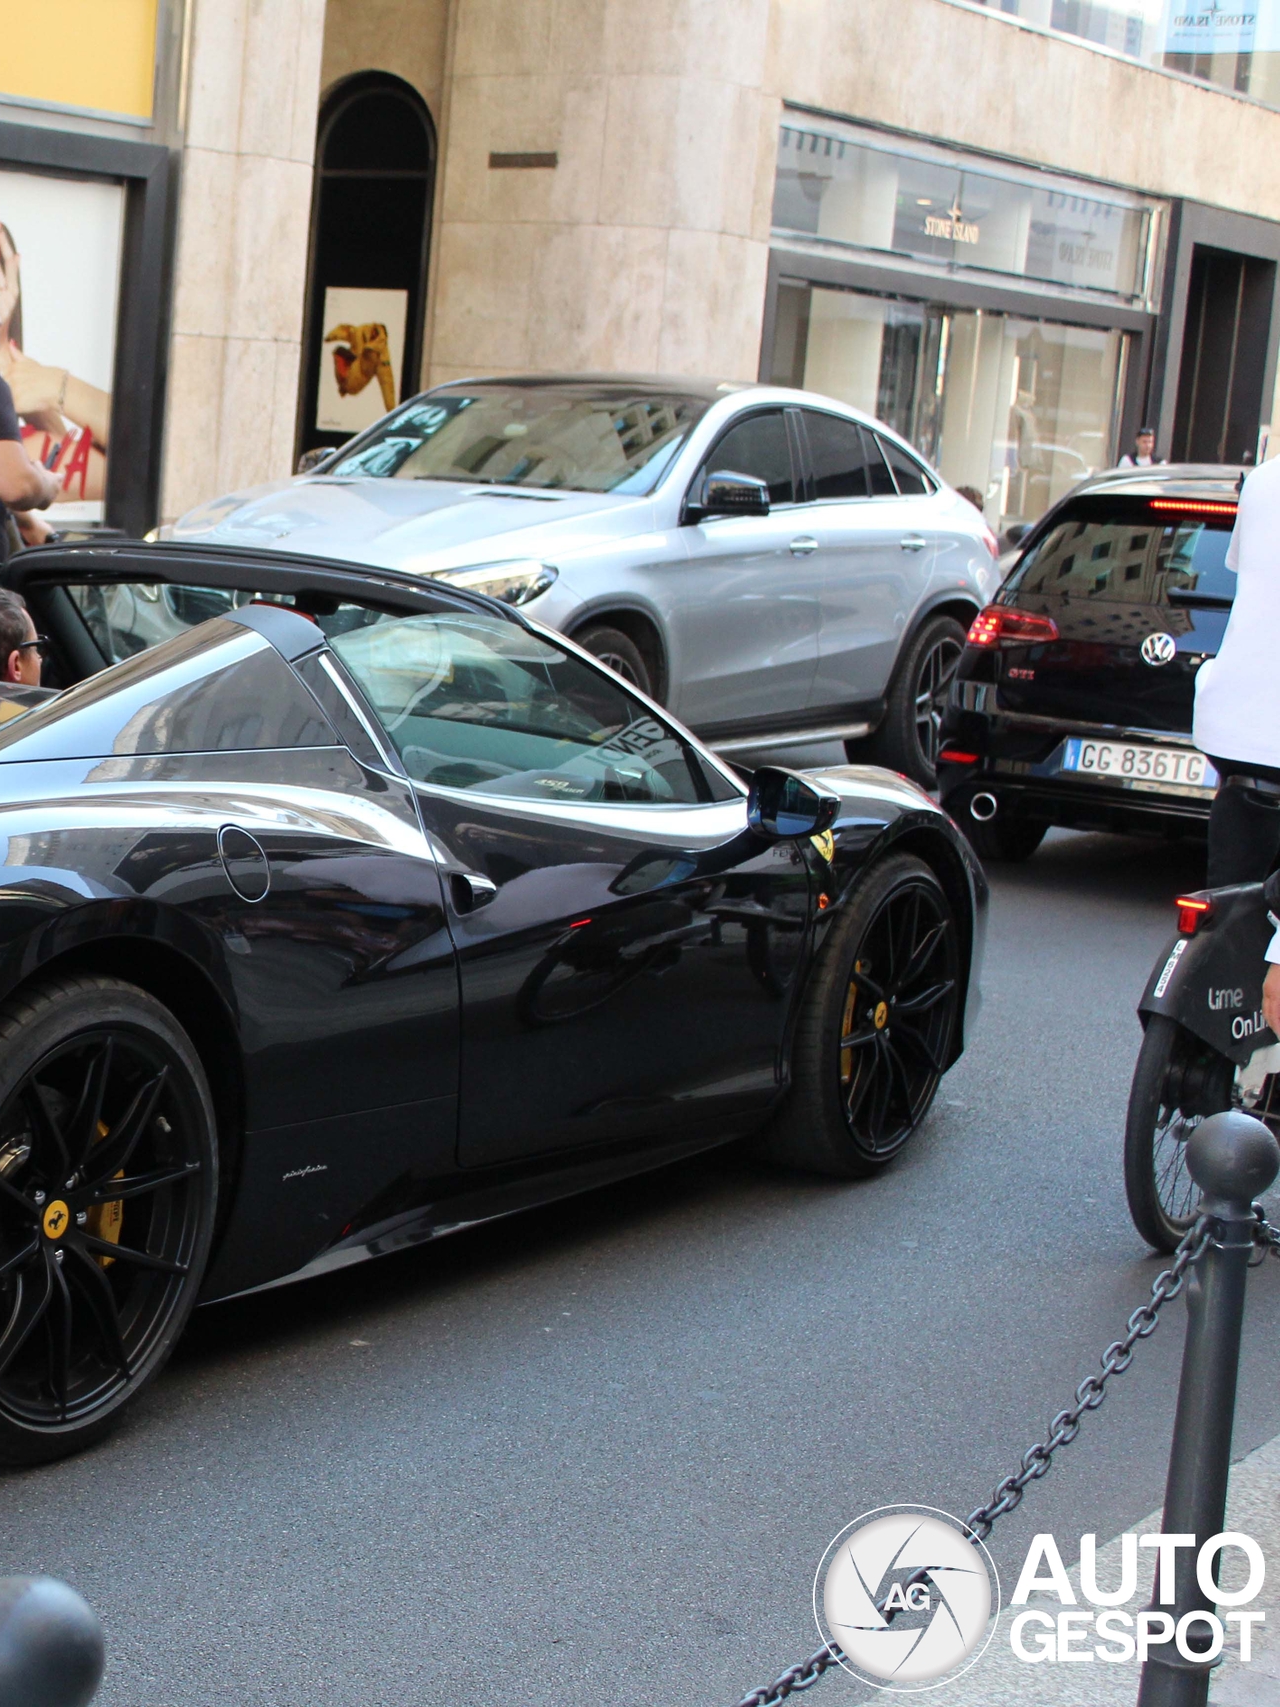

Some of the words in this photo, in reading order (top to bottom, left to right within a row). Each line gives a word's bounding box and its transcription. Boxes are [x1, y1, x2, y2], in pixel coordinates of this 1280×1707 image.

[924, 215, 952, 240] STONE
[953, 222, 980, 245] ISLAND
[1008, 668, 1035, 680] GTI
[1081, 744, 1111, 771] GG
[1121, 749, 1203, 783] 836TG
[1208, 987, 1243, 1010] Lime
